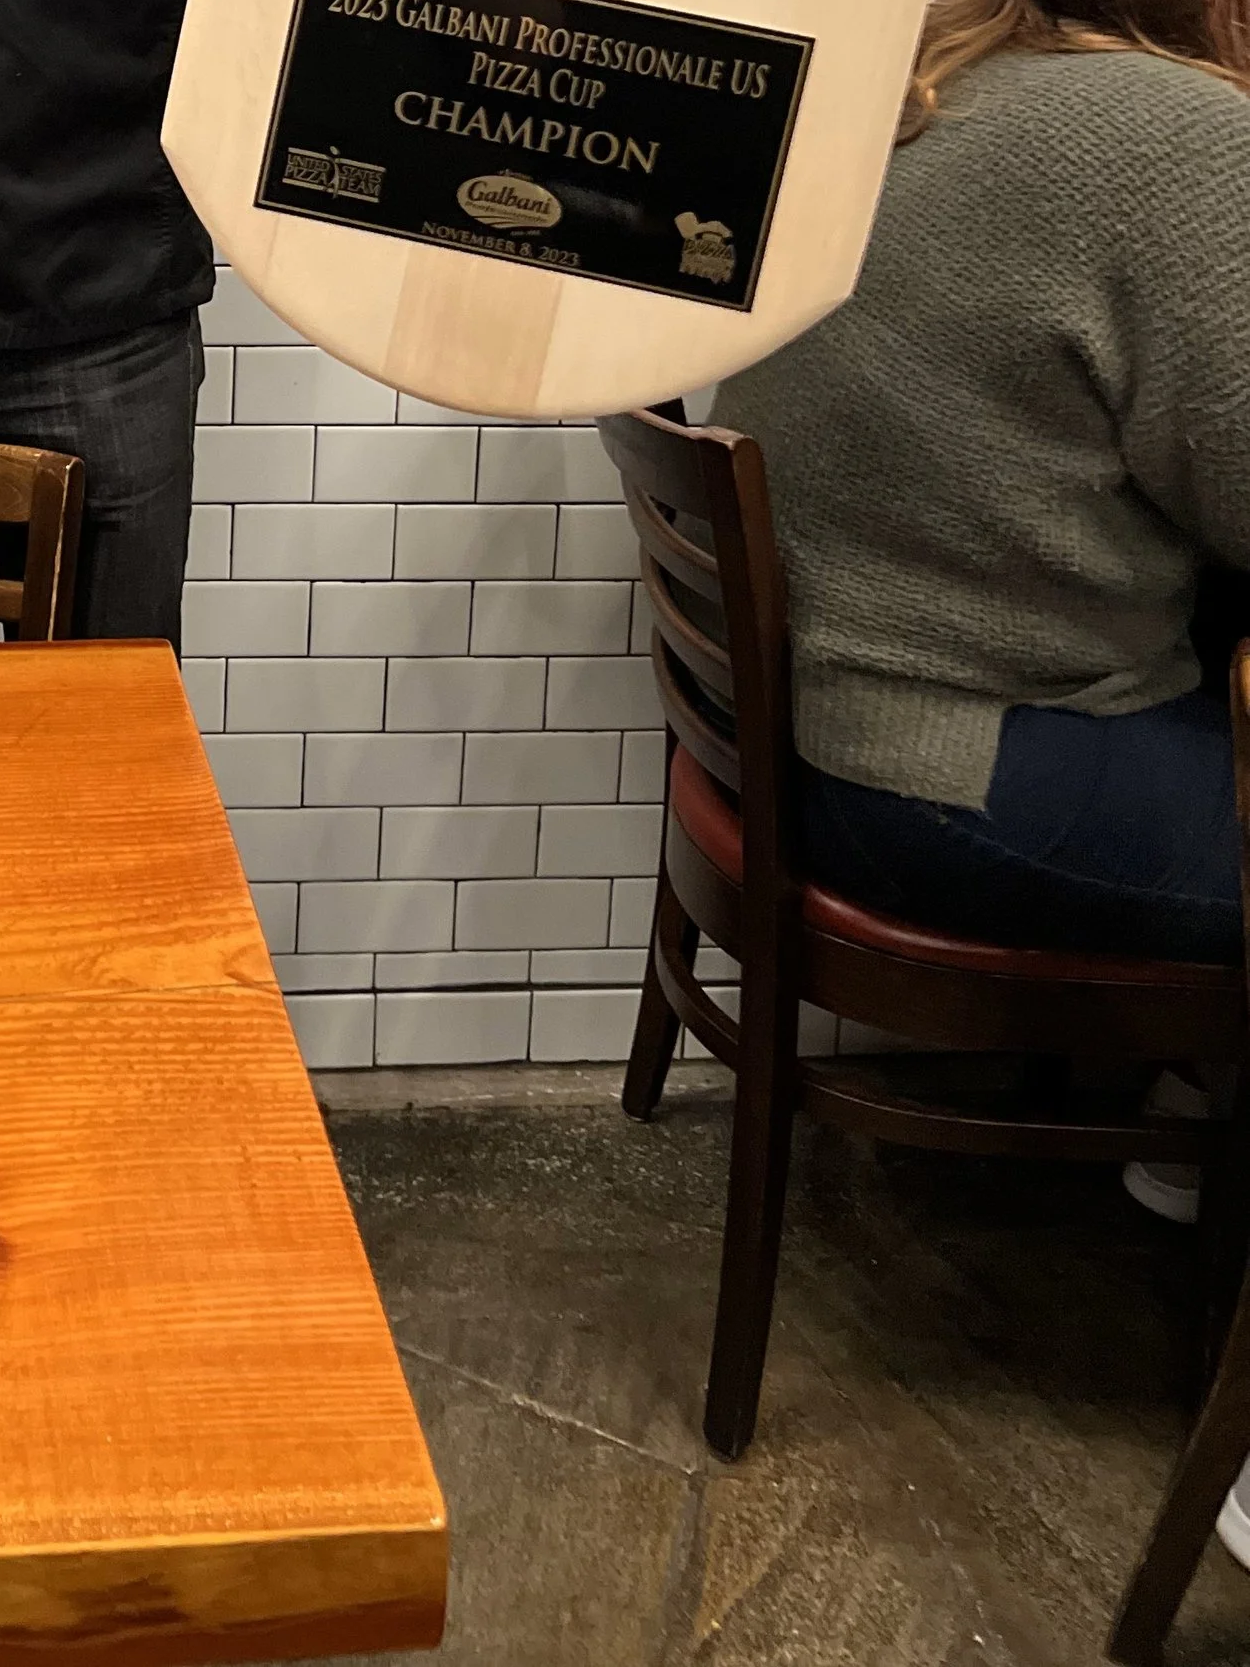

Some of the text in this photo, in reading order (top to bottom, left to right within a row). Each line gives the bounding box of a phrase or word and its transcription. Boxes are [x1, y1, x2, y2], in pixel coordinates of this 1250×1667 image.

[467, 50, 607, 110] PIZZA CUP
[514, 16, 725, 91] PROFESSIONALE
[730, 59, 771, 99] US
[393, 90, 662, 175] CHAMPION
[285, 165, 381, 196] PIZZA TEAM
[287, 154, 382, 183] UNITED STATES
[467, 181, 552, 215] Galbani
[421, 221, 516, 254] NOVEMBER
[538, 246, 581, 267] 2023
